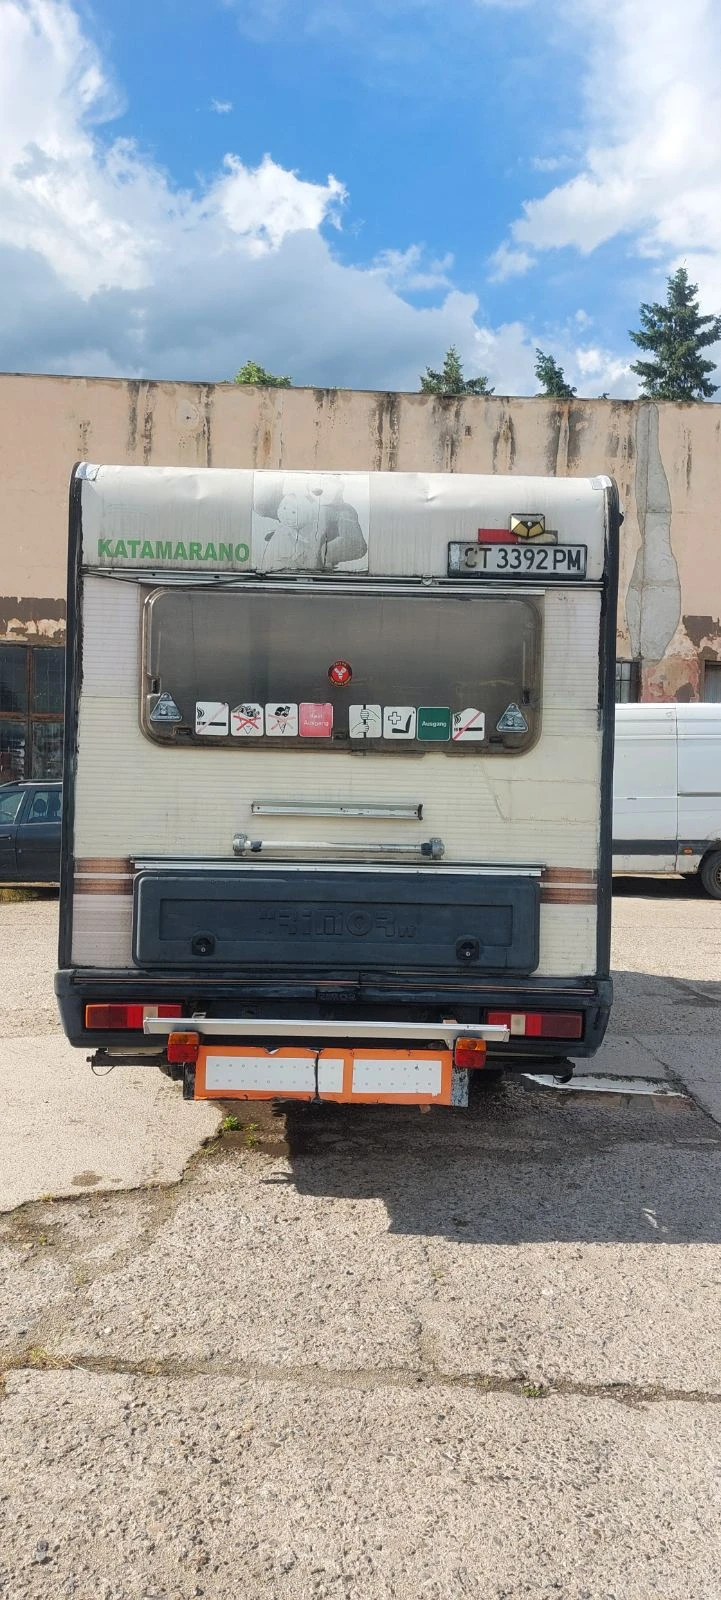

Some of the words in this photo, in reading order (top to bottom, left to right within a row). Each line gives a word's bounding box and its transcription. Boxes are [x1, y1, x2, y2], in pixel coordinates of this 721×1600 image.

[97, 538, 250, 563] KATAMARANO
[496, 548, 549, 570] 3392
[553, 549, 581, 571] PM
[421, 720, 447, 728] Ausgang
